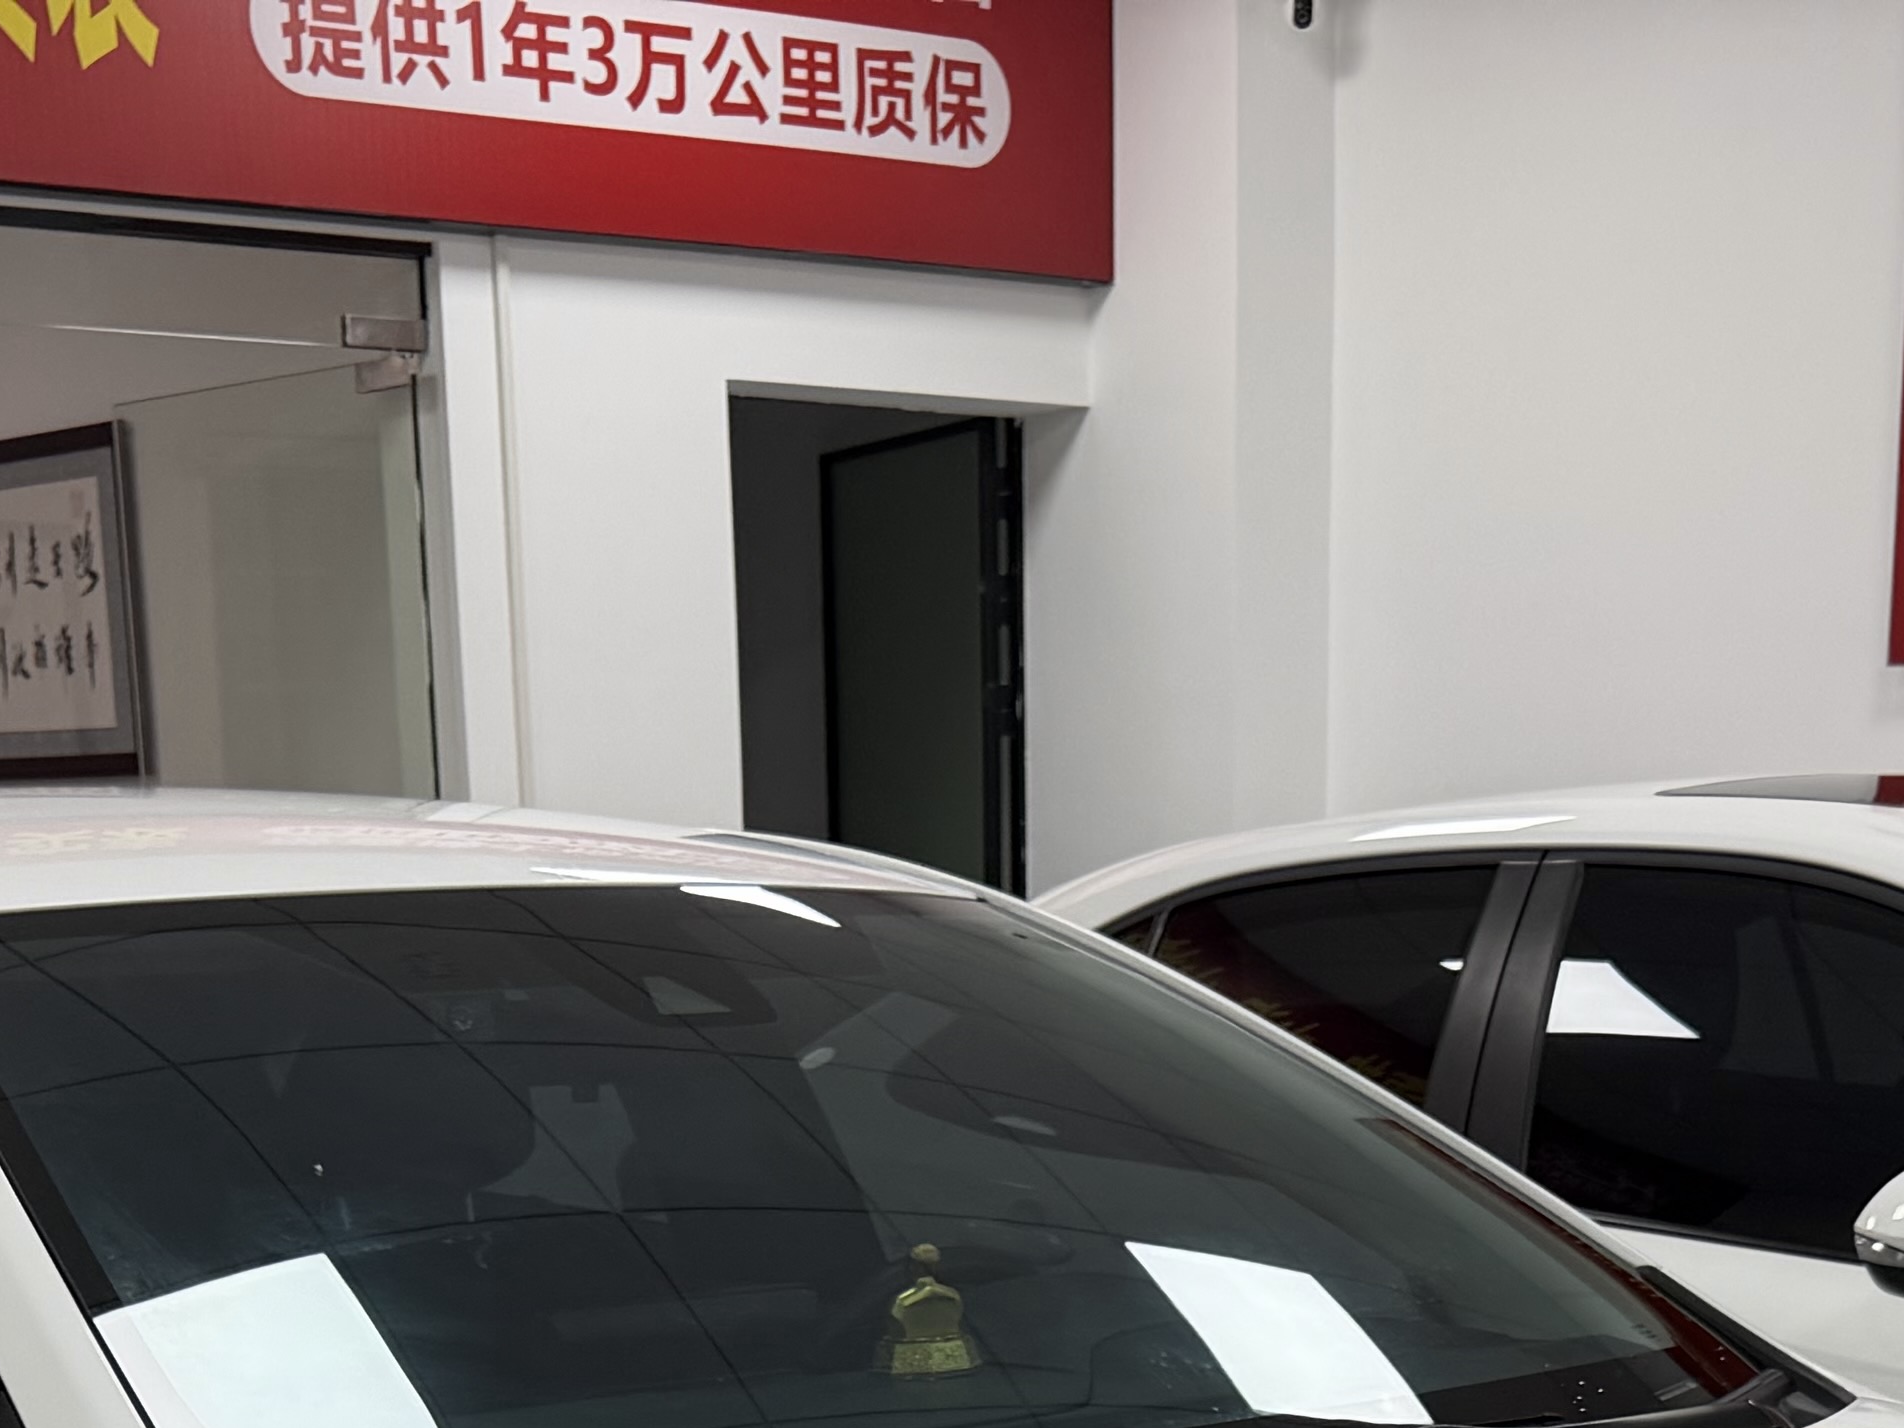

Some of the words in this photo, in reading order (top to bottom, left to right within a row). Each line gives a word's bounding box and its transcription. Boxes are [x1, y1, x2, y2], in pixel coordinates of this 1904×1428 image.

[282, 0, 988, 151] 提供1年3万公里质保
